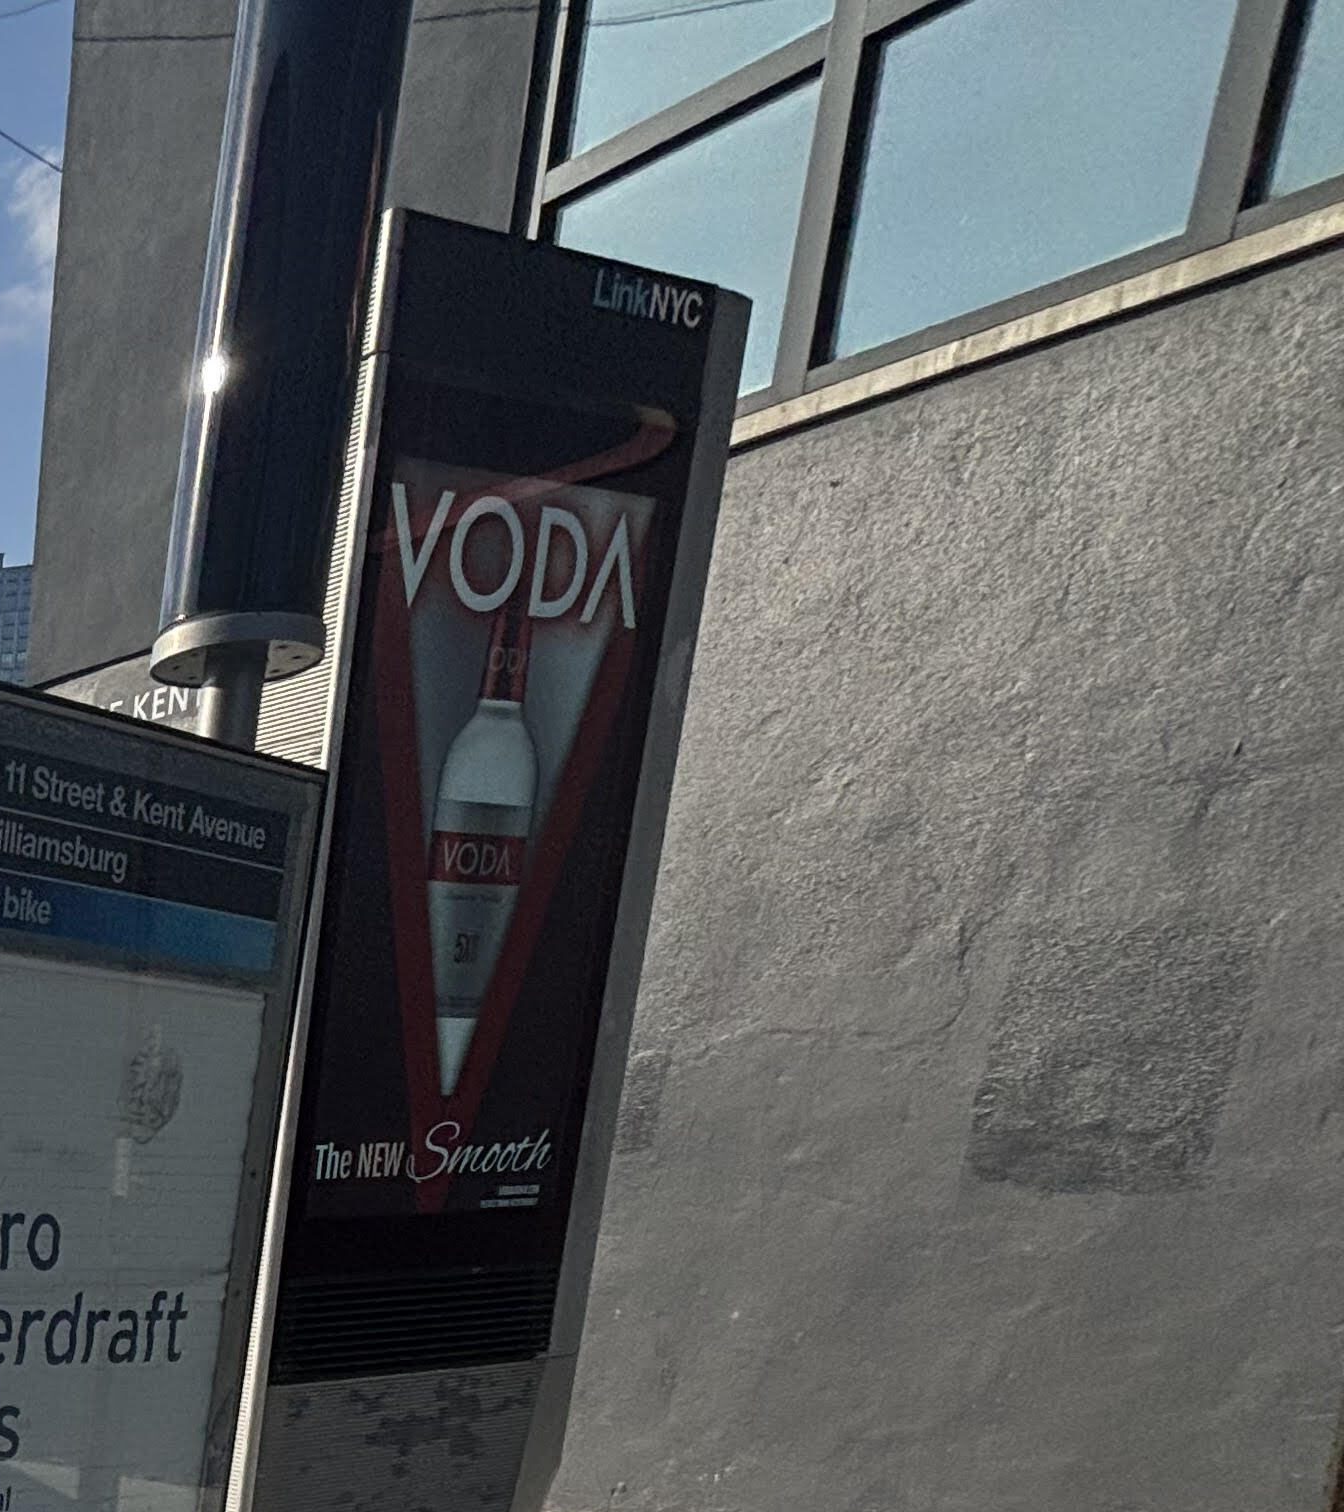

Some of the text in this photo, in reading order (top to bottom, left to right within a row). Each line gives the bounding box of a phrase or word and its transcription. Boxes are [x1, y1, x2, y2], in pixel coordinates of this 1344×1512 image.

[592, 268, 703, 328] LinkNYC
[392, 482, 636, 629] VODA
[6, 759, 25, 794] 11
[32, 765, 104, 816] Street
[111, 785, 127, 818] &
[133, 789, 184, 831] Kent
[188, 805, 266, 850] Avenue
[444, 840, 511, 876] VODA
[315, 1121, 552, 1183] The NEW Smooth
